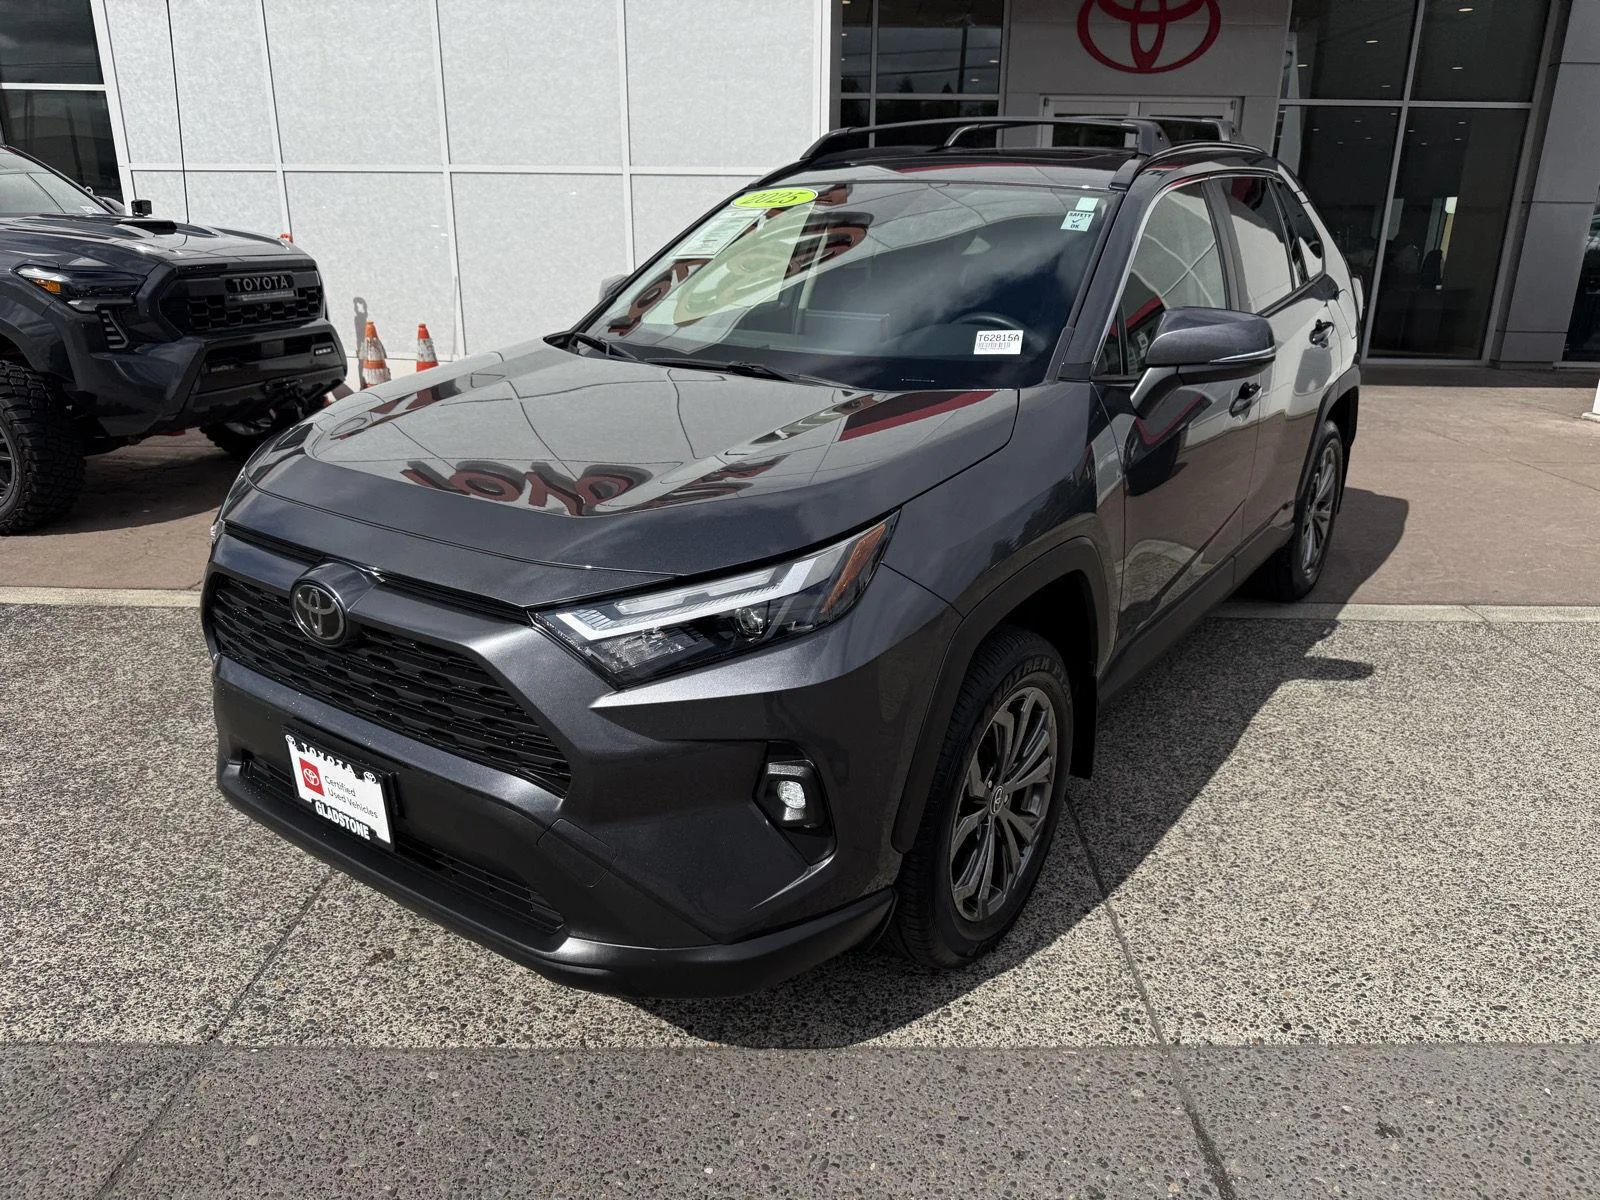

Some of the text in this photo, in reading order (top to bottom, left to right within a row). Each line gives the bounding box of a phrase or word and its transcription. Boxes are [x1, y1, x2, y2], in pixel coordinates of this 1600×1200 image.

[232, 276, 289, 291] TOYOTA
[978, 333, 1020, 342] T62815A
[301, 742, 353, 774] TOYOTA
[324, 775, 356, 797] Certified
[327, 787, 379, 819] Used Vehicles
[314, 801, 371, 841] GLADSTONE
